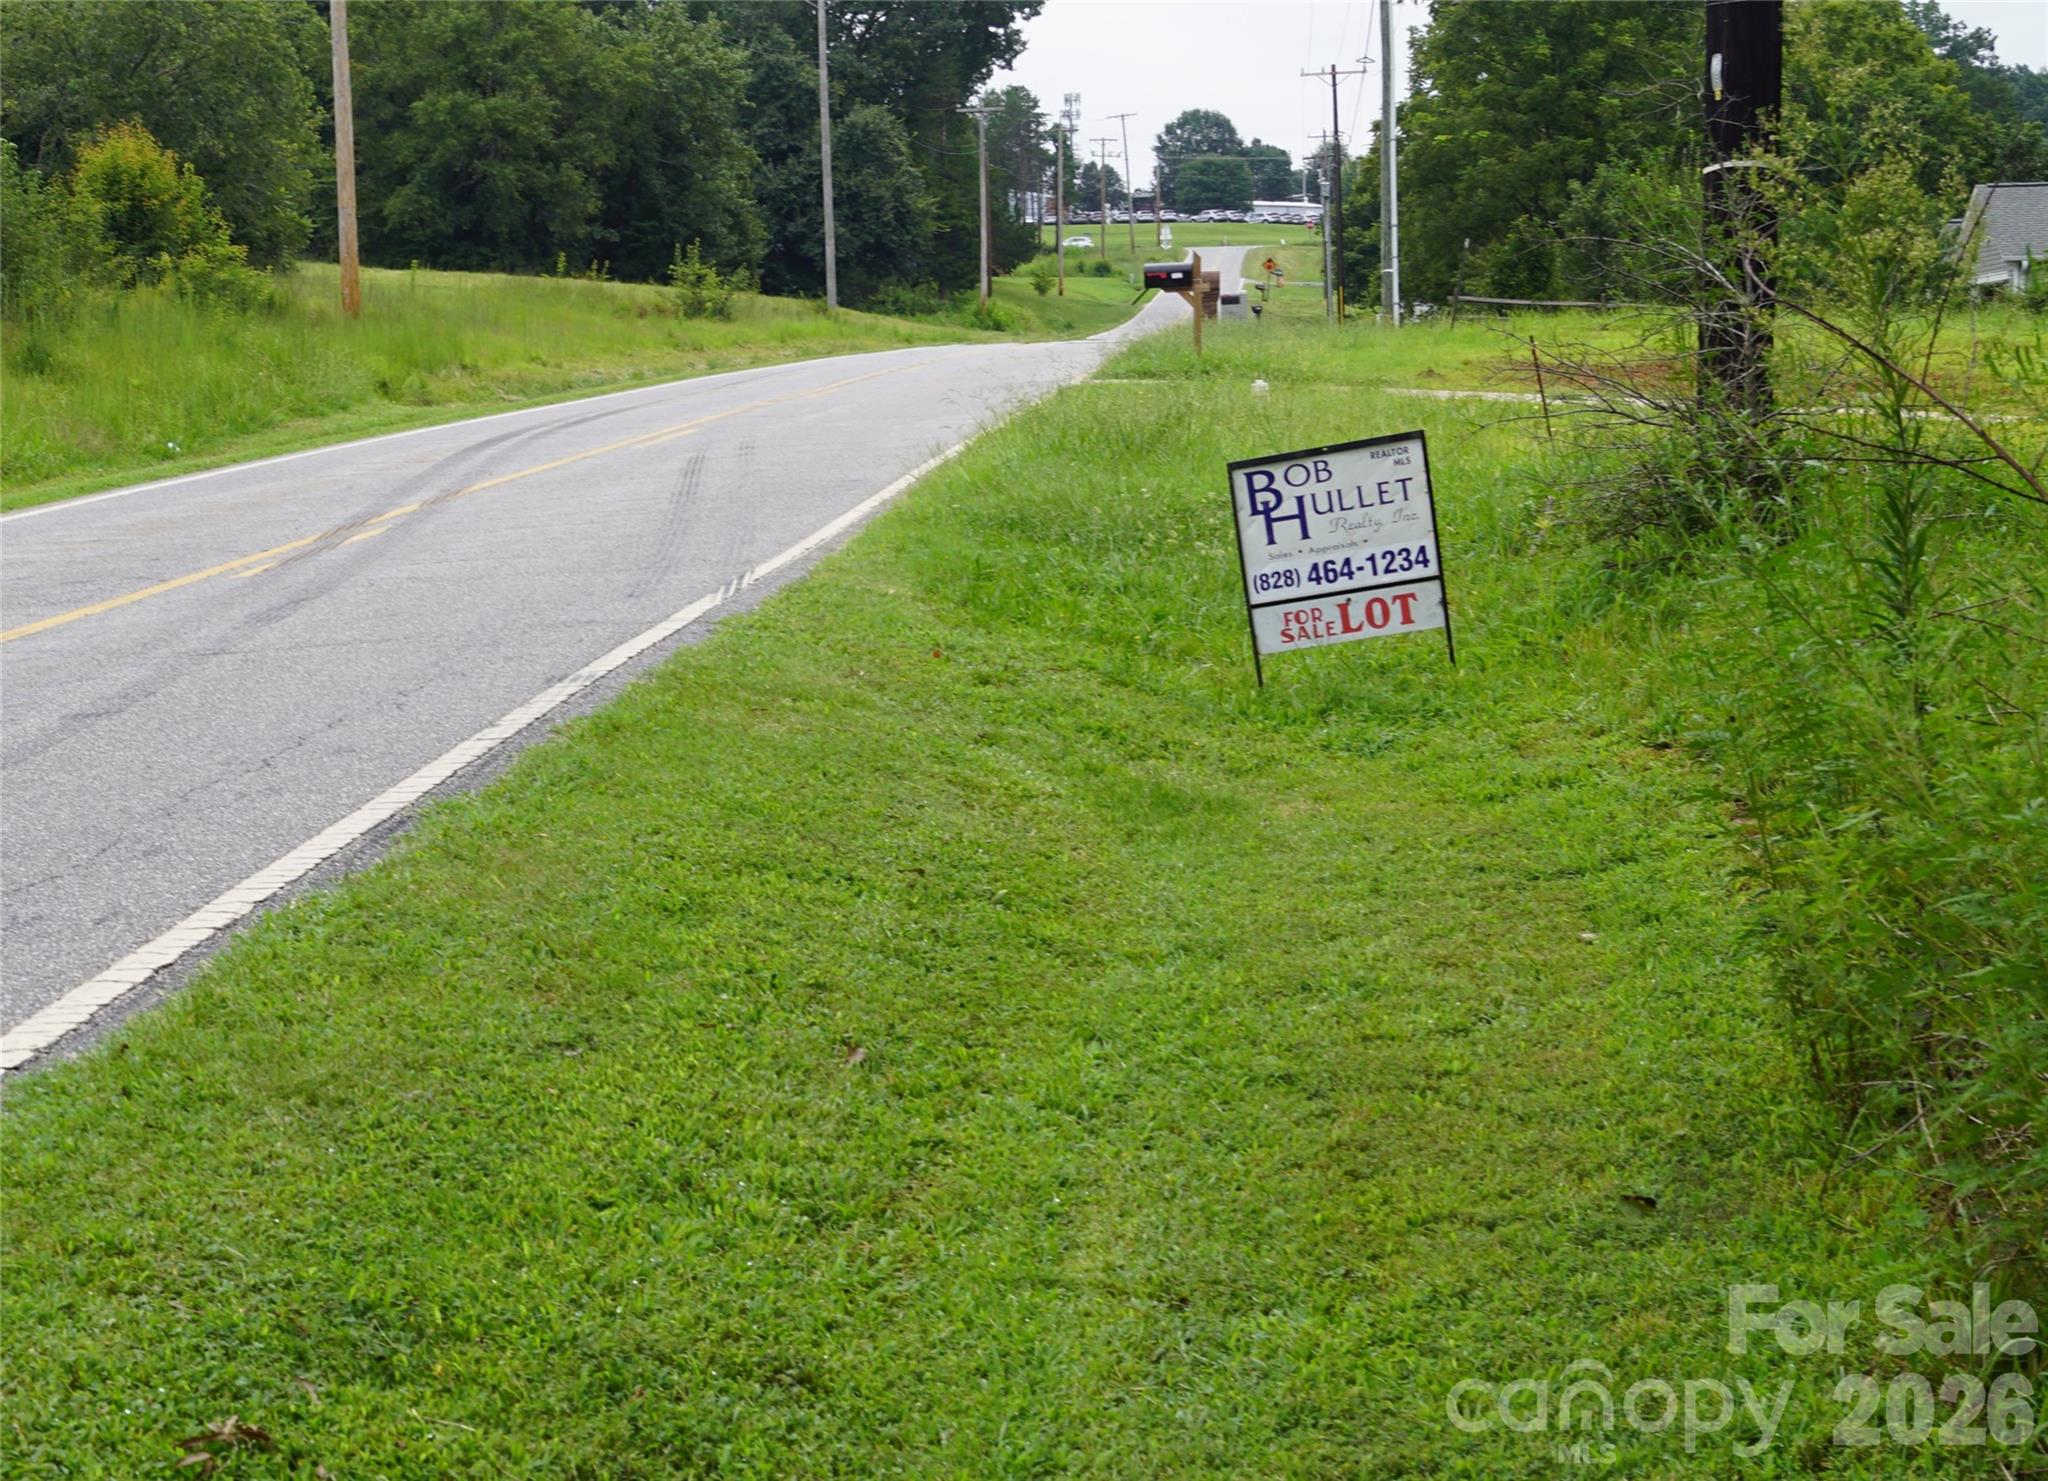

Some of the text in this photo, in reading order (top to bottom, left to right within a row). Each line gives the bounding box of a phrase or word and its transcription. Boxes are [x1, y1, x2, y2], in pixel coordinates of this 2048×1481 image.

[1370, 446, 1409, 459] REALTOR
[1393, 456, 1412, 466] MLS
[1243, 459, 1333, 517] BOB
[1260, 477, 1413, 546] HULLET
[1328, 512, 1383, 533] Realty
[1253, 545, 1430, 594] (828) 464-1234
[1283, 607, 1323, 628] FOR
[1335, 592, 1418, 635] LOT
[1279, 620, 1337, 644] SALE
